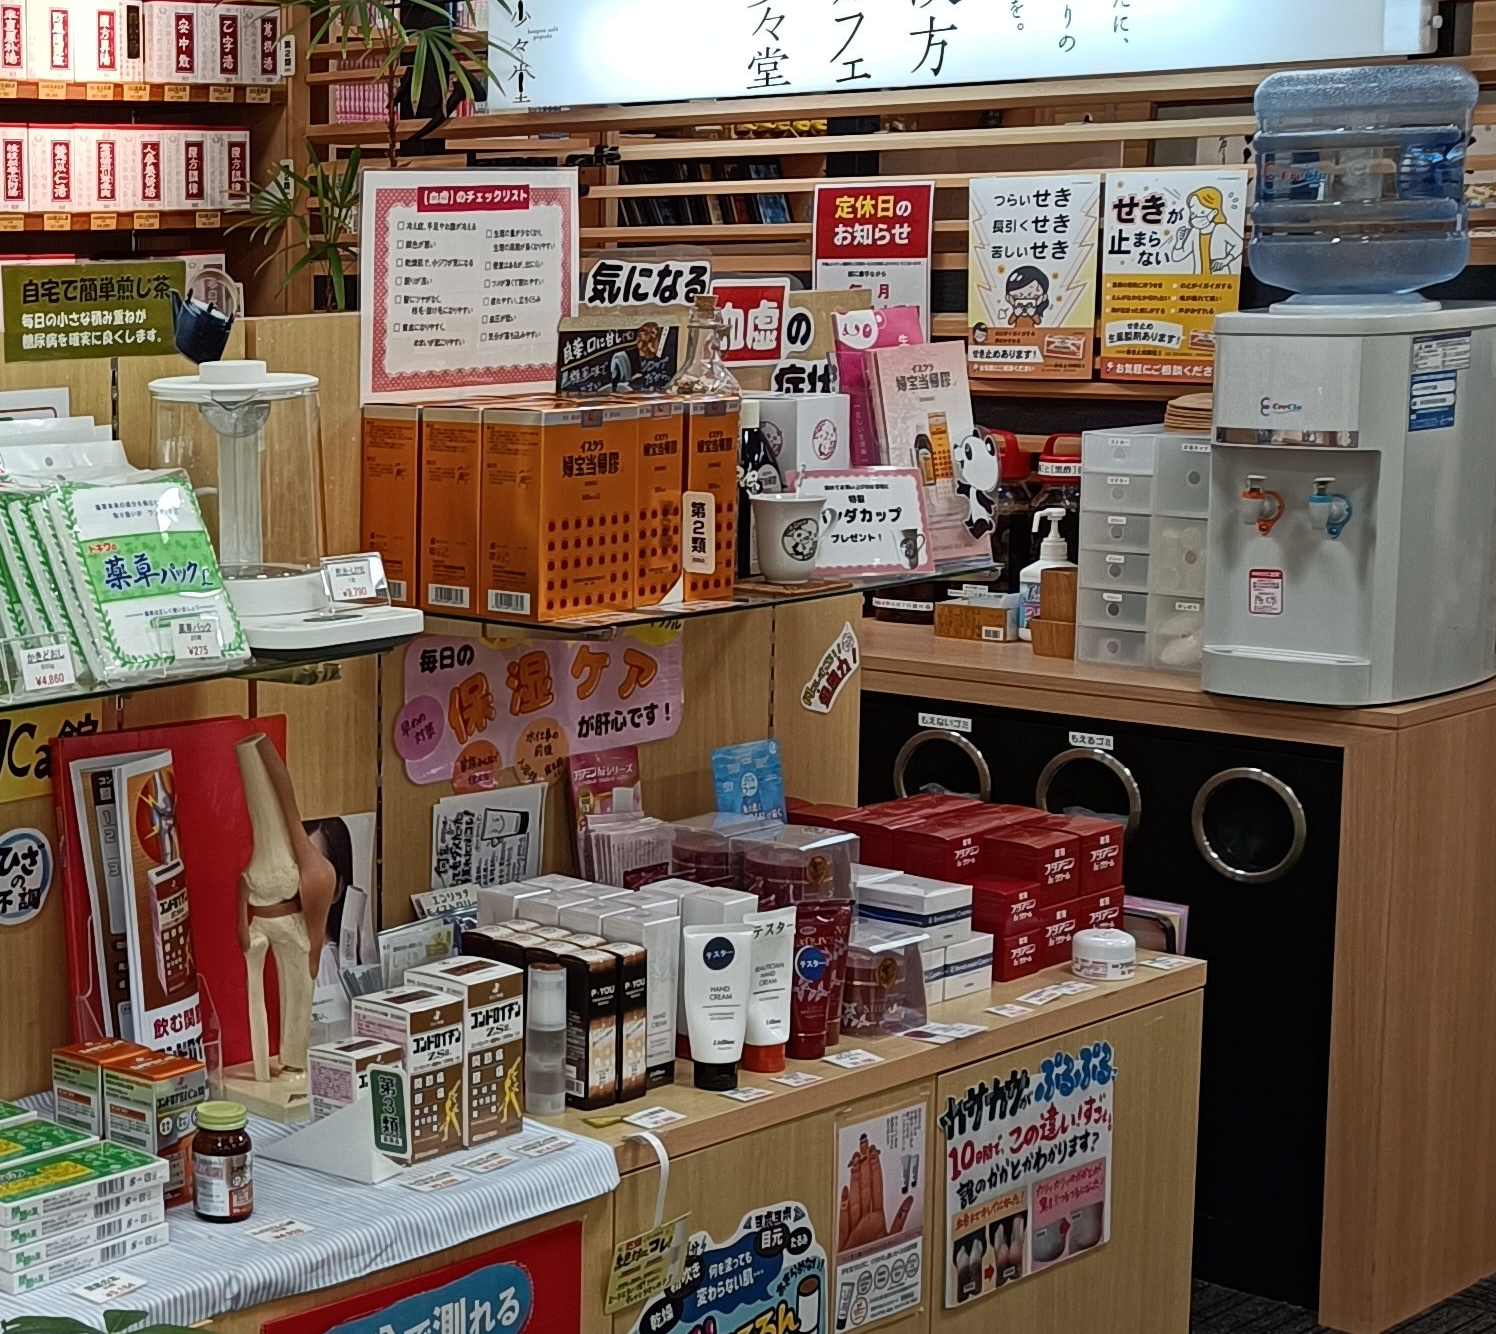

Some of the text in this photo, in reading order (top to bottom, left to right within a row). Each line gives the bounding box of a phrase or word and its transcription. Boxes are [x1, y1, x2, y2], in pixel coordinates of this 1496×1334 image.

[177, 18, 191, 69] 安中散
[221, 20, 235, 70] 乙字湯
[835, 195, 912, 218] 定休日の
[993, 187, 1072, 208] つらいせき
[1112, 193, 1185, 225] せきが
[833, 223, 911, 246] お知らせ
[992, 213, 1071, 234] 長引くせき
[990, 240, 1069, 260] 苦しいせき
[1108, 229, 1161, 255] 止まら
[1137, 250, 1170, 266] ない
[21, 275, 172, 305] 自宅で簡単煎じ茶
[587, 261, 708, 304] 気になる
[21, 308, 147, 328] 毎日の小さな積み重ねが
[21, 329, 163, 350] 糖尿病を確実に良くします。
[580, 440, 604, 454] イスクラ
[690, 501, 706, 554] 第2類
[419, 644, 475, 674] 毎日の
[447, 644, 659, 745] 保湿ケア
[577, 702, 672, 739] が肝心です!
[919, 714, 971, 730] もえないゴミ
[1070, 733, 1112, 748] もえるゴミ
[10, 874, 25, 889] の
[753, 922, 794, 939] テスター
[706, 950, 734, 960] テスター
[709, 993, 733, 1001] CREAM
[710, 985, 731, 993] HAND
[470, 1001, 522, 1031] コンドロイチン
[412, 1027, 462, 1056] コンドロイチン
[378, 1076, 401, 1138] 第3類
[956, 1128, 1101, 1211] 誰のかかとかわかります?
[761, 1230, 784, 1250] 目元
[708, 1251, 753, 1279] 何を塗っても
[649, 1304, 675, 1331] 乾燥
